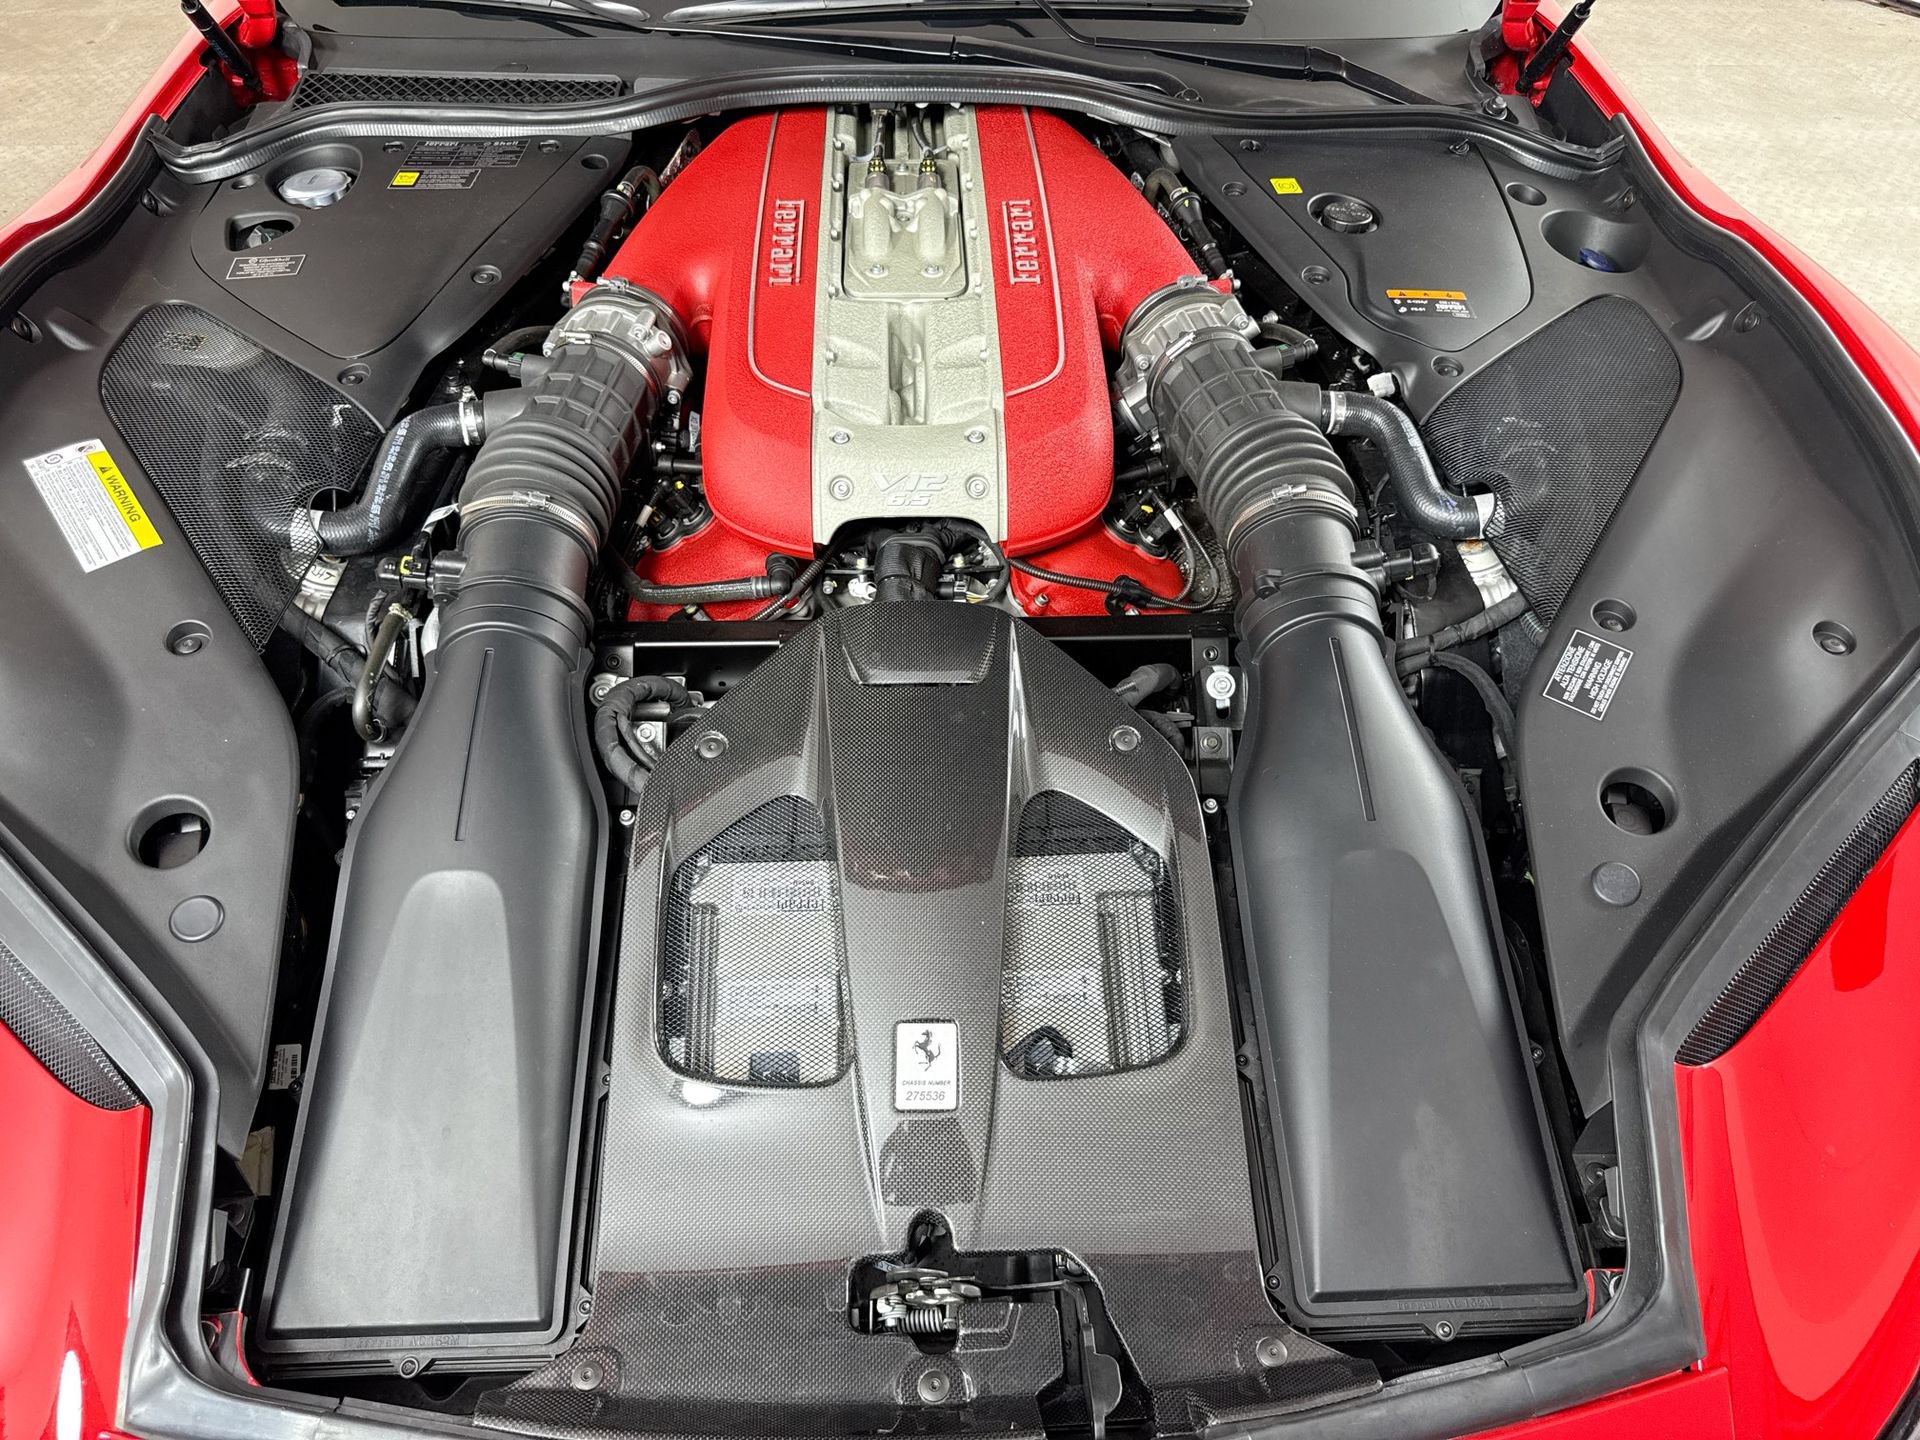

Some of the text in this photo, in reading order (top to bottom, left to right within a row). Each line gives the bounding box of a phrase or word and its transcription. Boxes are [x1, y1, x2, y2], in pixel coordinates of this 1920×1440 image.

[768, 199, 804, 287] Ferrari
[1002, 199, 1040, 285] Ferrari
[106, 474, 140, 523] WARNING
[872, 474, 948, 492] V12
[886, 494, 933, 506] 6.5
[1554, 645, 1576, 682] ATTENZIONE
[1559, 645, 1585, 688] ALTA TENSIONE
[1583, 661, 1602, 689] WARNING
[1588, 658, 1613, 699] HIGH VOLTAGE
[906, 1090, 946, 1101] 275536
